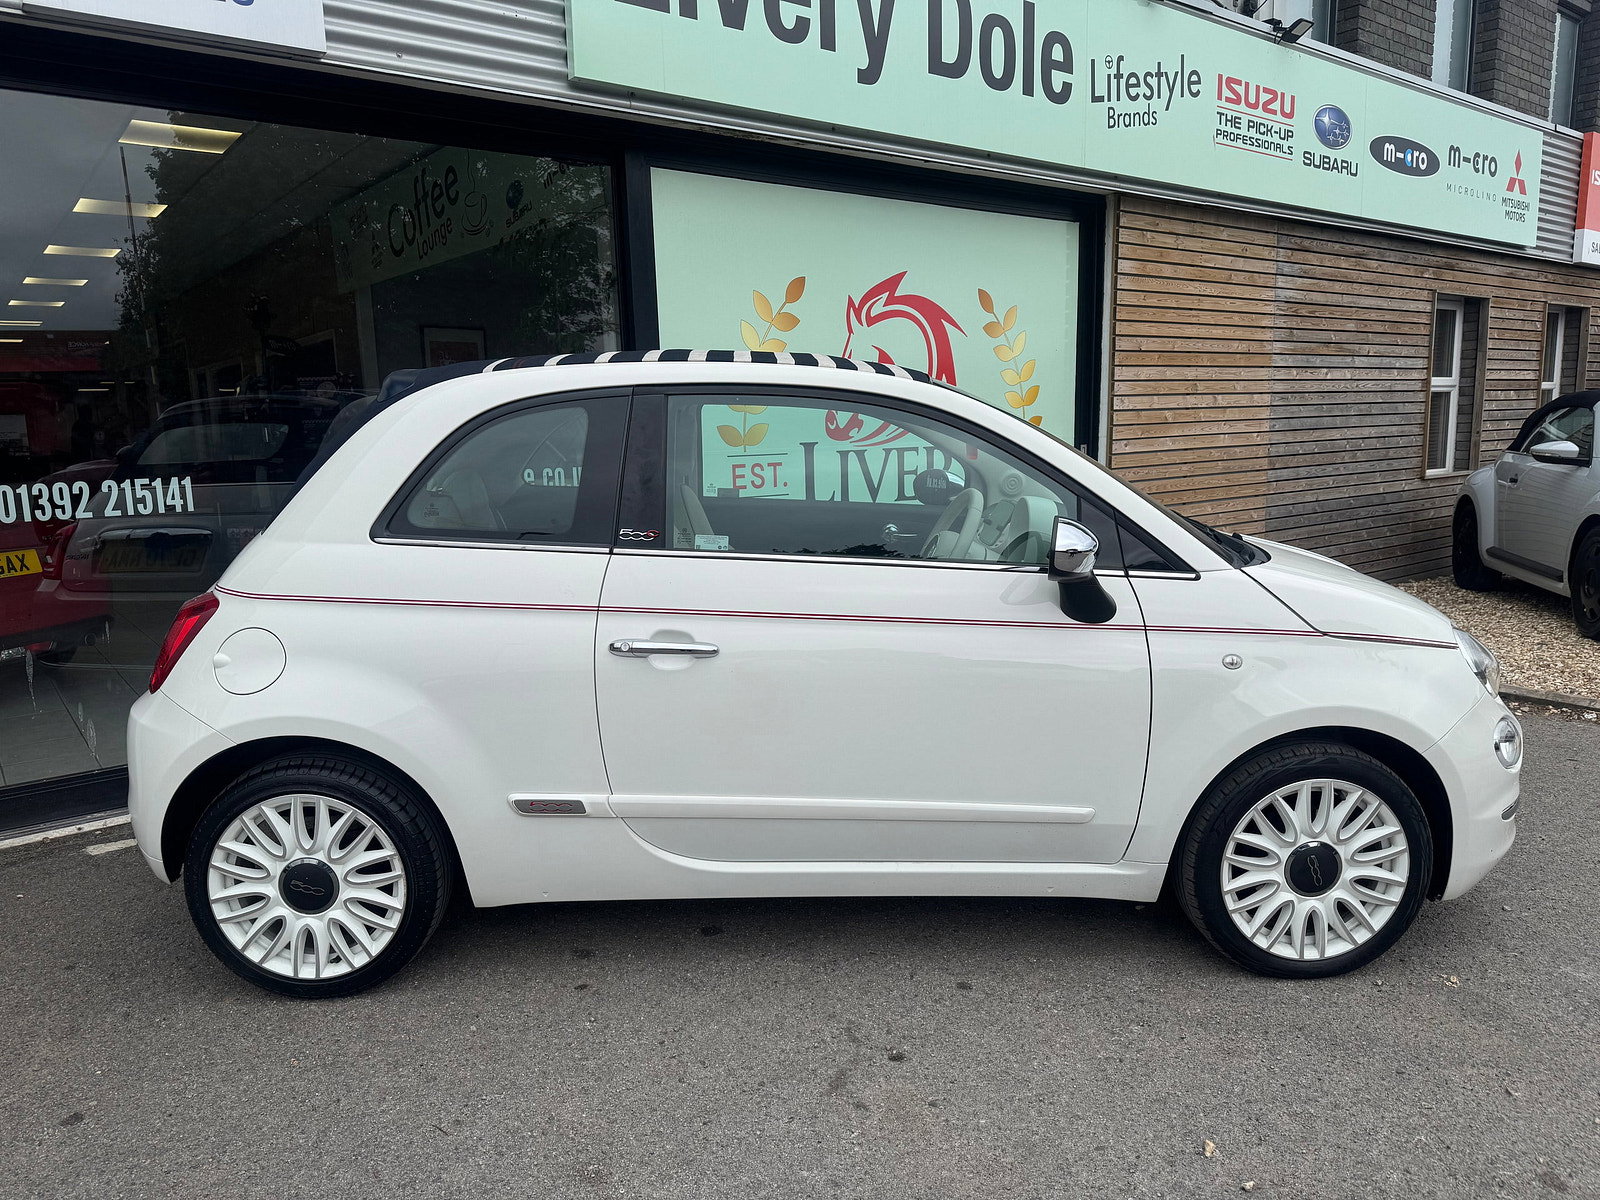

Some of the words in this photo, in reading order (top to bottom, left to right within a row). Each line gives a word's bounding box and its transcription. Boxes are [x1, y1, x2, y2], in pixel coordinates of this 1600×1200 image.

[928, 0, 1074, 105] Dole
[1090, 54, 1202, 111] Lifestyle
[1217, 73, 1296, 120] ISUZU
[1107, 103, 1158, 129] Brands
[1216, 111, 1242, 131] THE
[1247, 119, 1294, 142] PICK-UP
[1215, 129, 1293, 156] PROFESSIONALS
[1302, 151, 1359, 178] SUBARU
[1446, 183, 1497, 202] MICROLINO
[1501, 197, 1530, 212] MITSUBISHI
[387, 164, 459, 258] Coffee
[1504, 209, 1526, 223] MOTORS
[416, 217, 454, 260] Lounge
[731, 461, 788, 490] EST.
[0, 481, 93, 524] 01392
[101, 476, 195, 517] 215141
